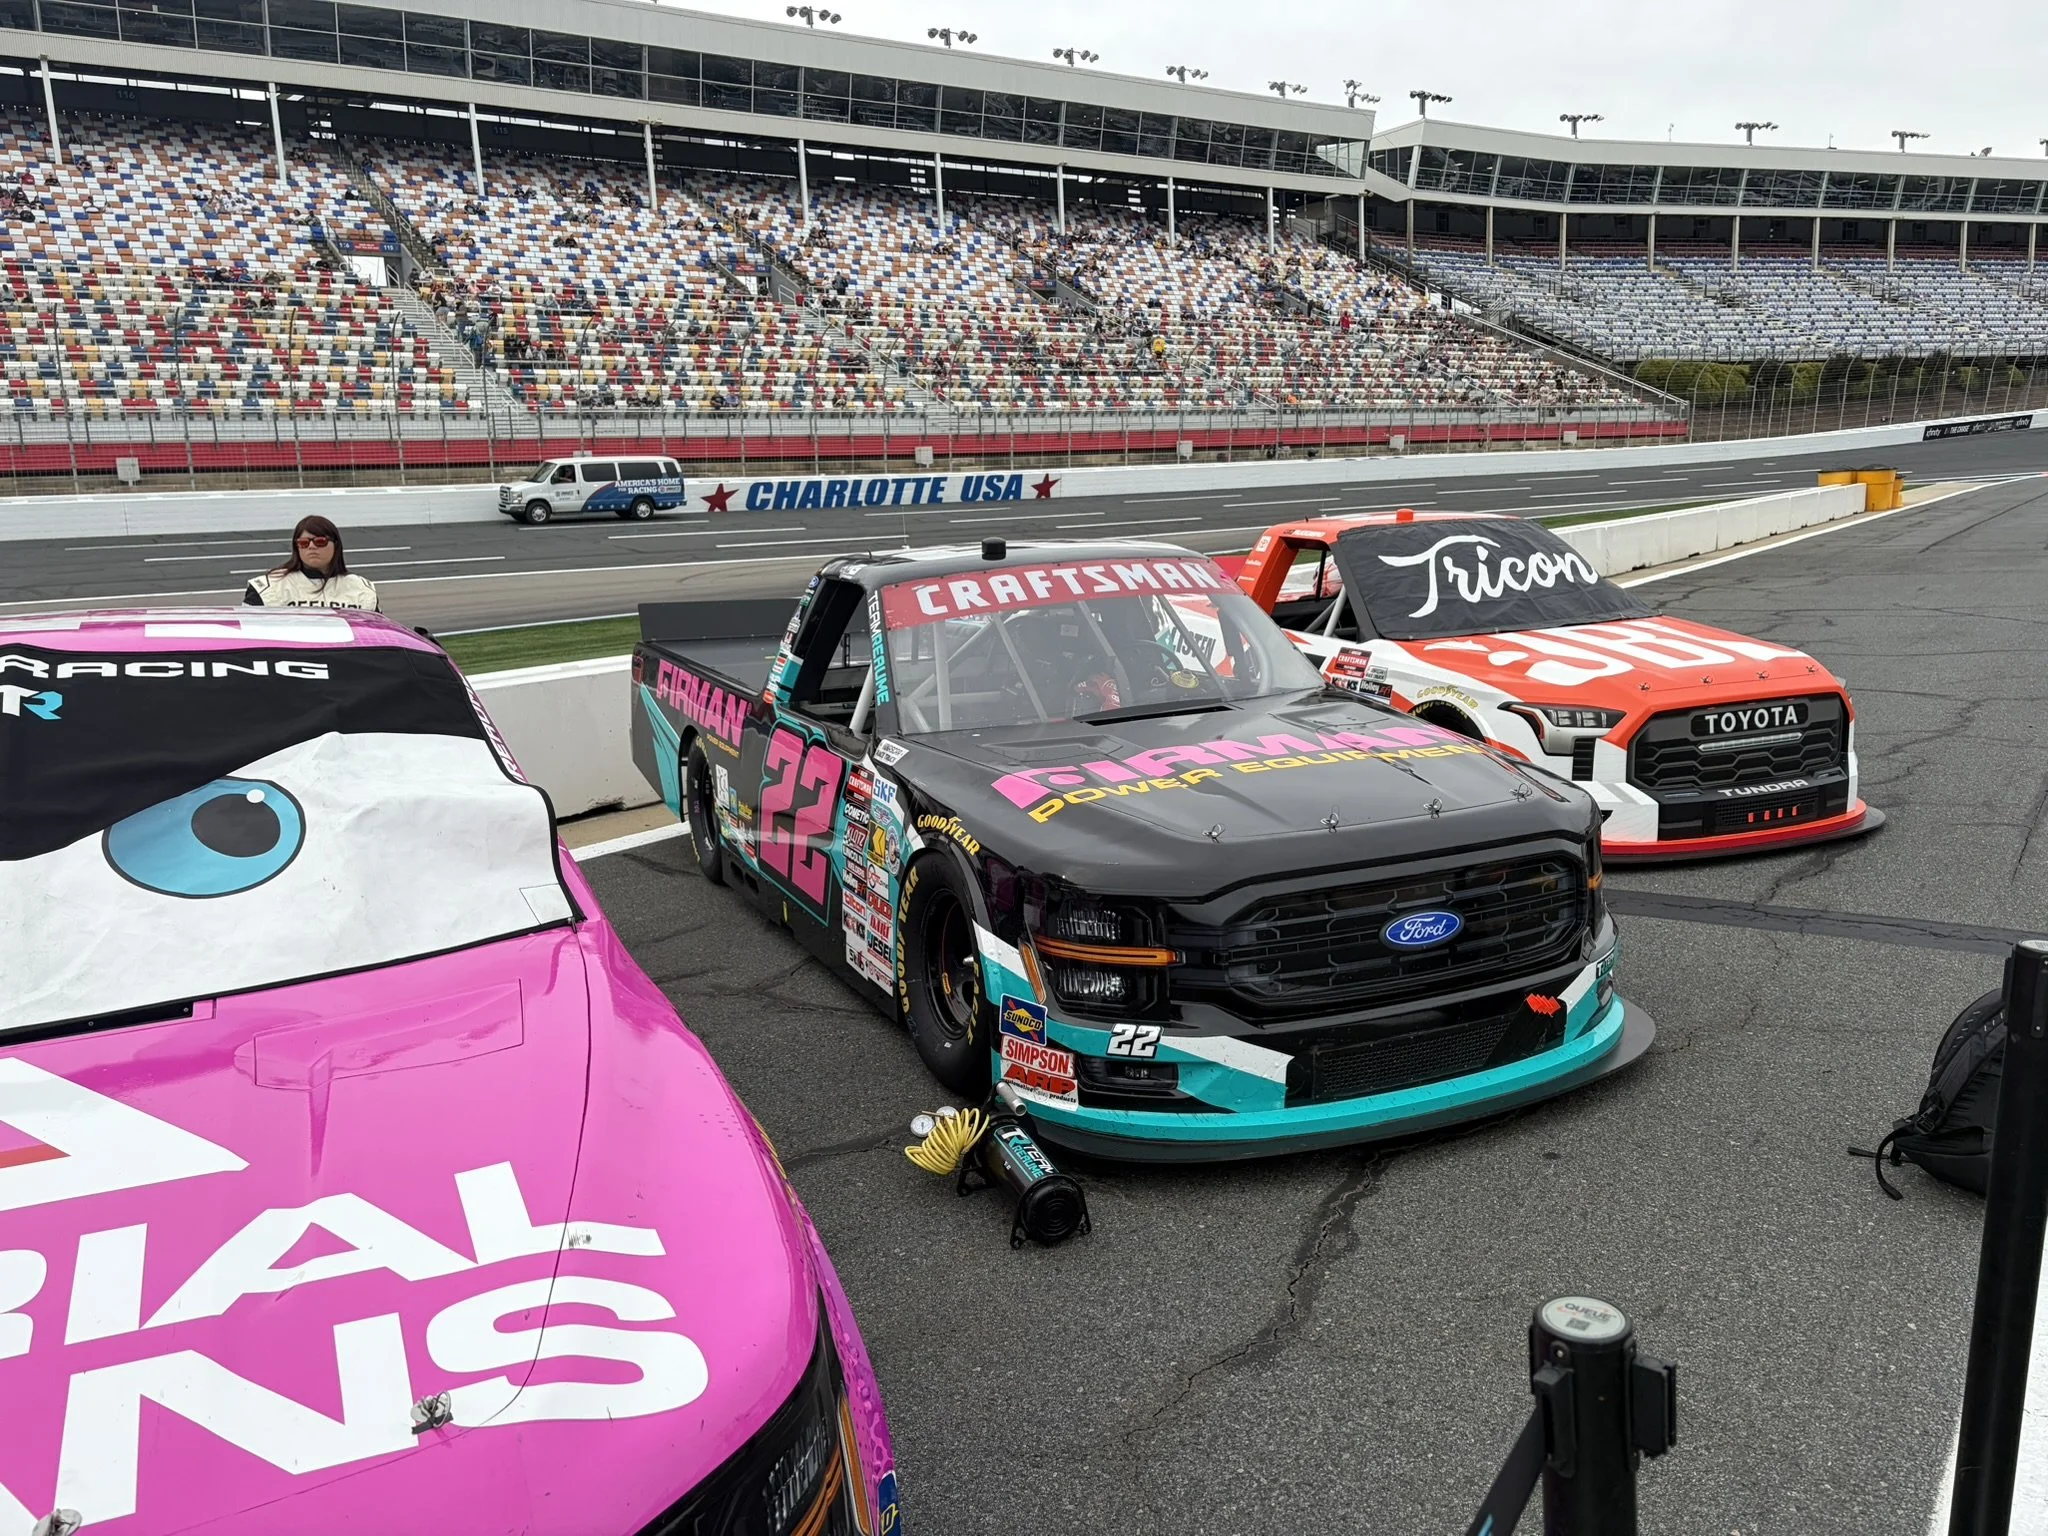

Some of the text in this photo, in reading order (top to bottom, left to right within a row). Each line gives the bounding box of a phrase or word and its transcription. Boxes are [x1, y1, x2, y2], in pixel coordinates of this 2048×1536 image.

[614, 478, 681, 488] AMERICA'S HOME
[628, 486, 658, 495] RACING
[745, 473, 1024, 511] CHARLOTTE USA
[912, 562, 1221, 616] CRAFTSMAN
[1378, 534, 1600, 618] Tricon
[656, 658, 748, 748] FIRMAN
[1416, 685, 1479, 710] GOODYEAR
[1704, 705, 1798, 734] TOYOTA
[873, 778, 896, 803] SKF
[1027, 742, 1485, 823] POWER EQUIPMEN
[1717, 779, 1809, 797] TUNDRA
[760, 728, 842, 906] 22
[844, 803, 870, 825] COMETIC
[917, 814, 980, 857] GOODYEAR
[1400, 916, 1447, 941] Ford
[867, 929, 893, 965] JESEL
[968, 961, 980, 1046] EAGLE
[1005, 1010, 1042, 1030] SUNOCO
[1006, 1039, 1070, 1075] SIMPSON
[1107, 1023, 1162, 1057] 22
[1003, 1063, 1076, 1096] ARP
[1012, 1145, 1045, 1179] REAUME
[1023, 1144, 1055, 1174] TEAM
